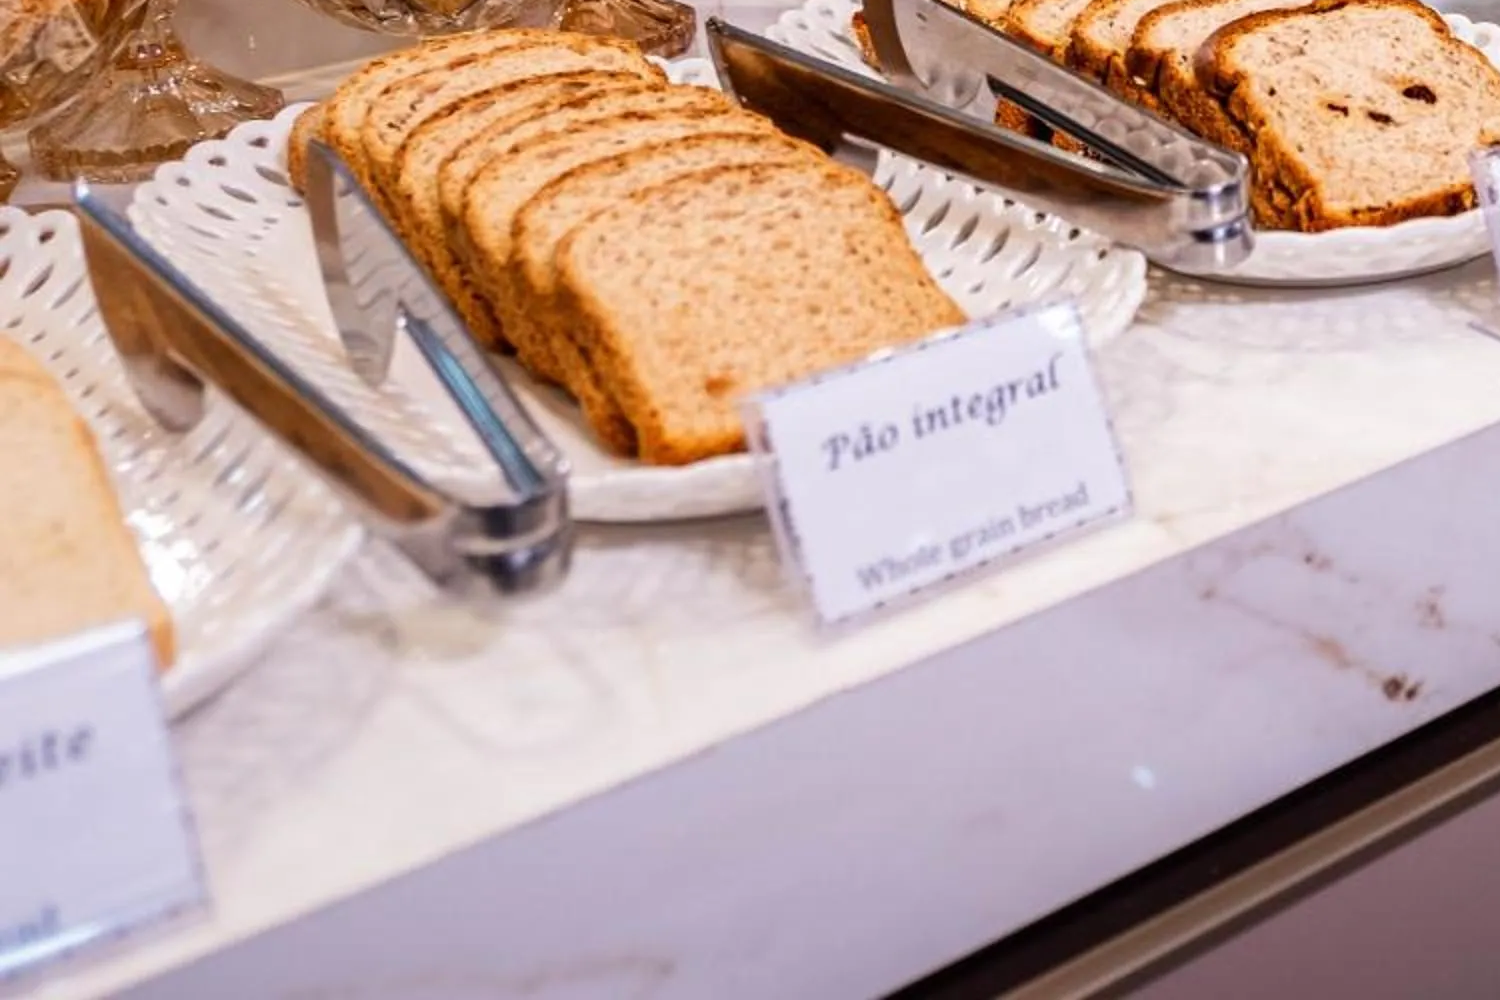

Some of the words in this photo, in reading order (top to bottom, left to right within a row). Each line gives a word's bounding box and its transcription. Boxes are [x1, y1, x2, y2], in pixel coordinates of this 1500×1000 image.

[820, 421, 900, 472] Pão
[911, 350, 1064, 440] integral
[855, 543, 943, 590] Whole
[948, 516, 1017, 560] grain
[1017, 480, 1090, 530] bread
